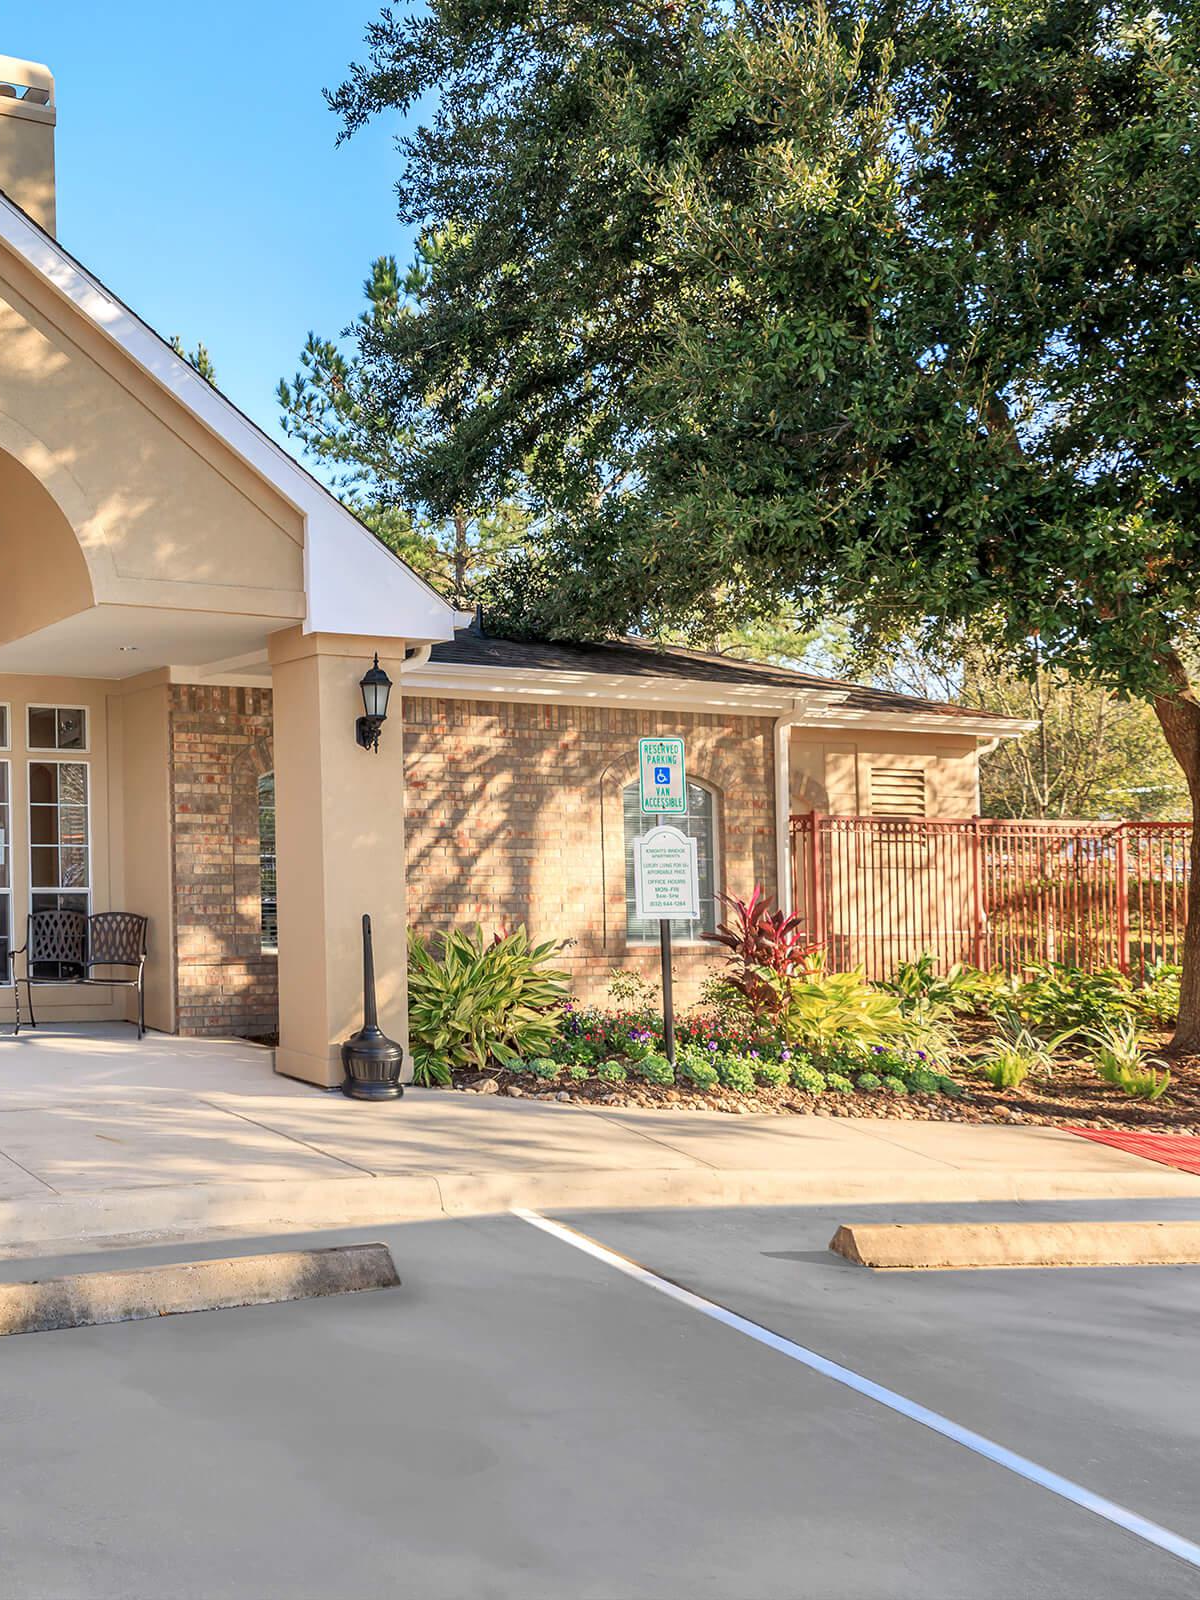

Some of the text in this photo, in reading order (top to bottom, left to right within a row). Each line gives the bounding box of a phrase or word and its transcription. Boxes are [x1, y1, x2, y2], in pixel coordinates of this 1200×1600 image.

[644, 744, 679, 754] RESERVED
[647, 755, 677, 765] PARKING
[655, 787, 671, 796] VAN
[645, 797, 682, 808] ACCESSIBLE
